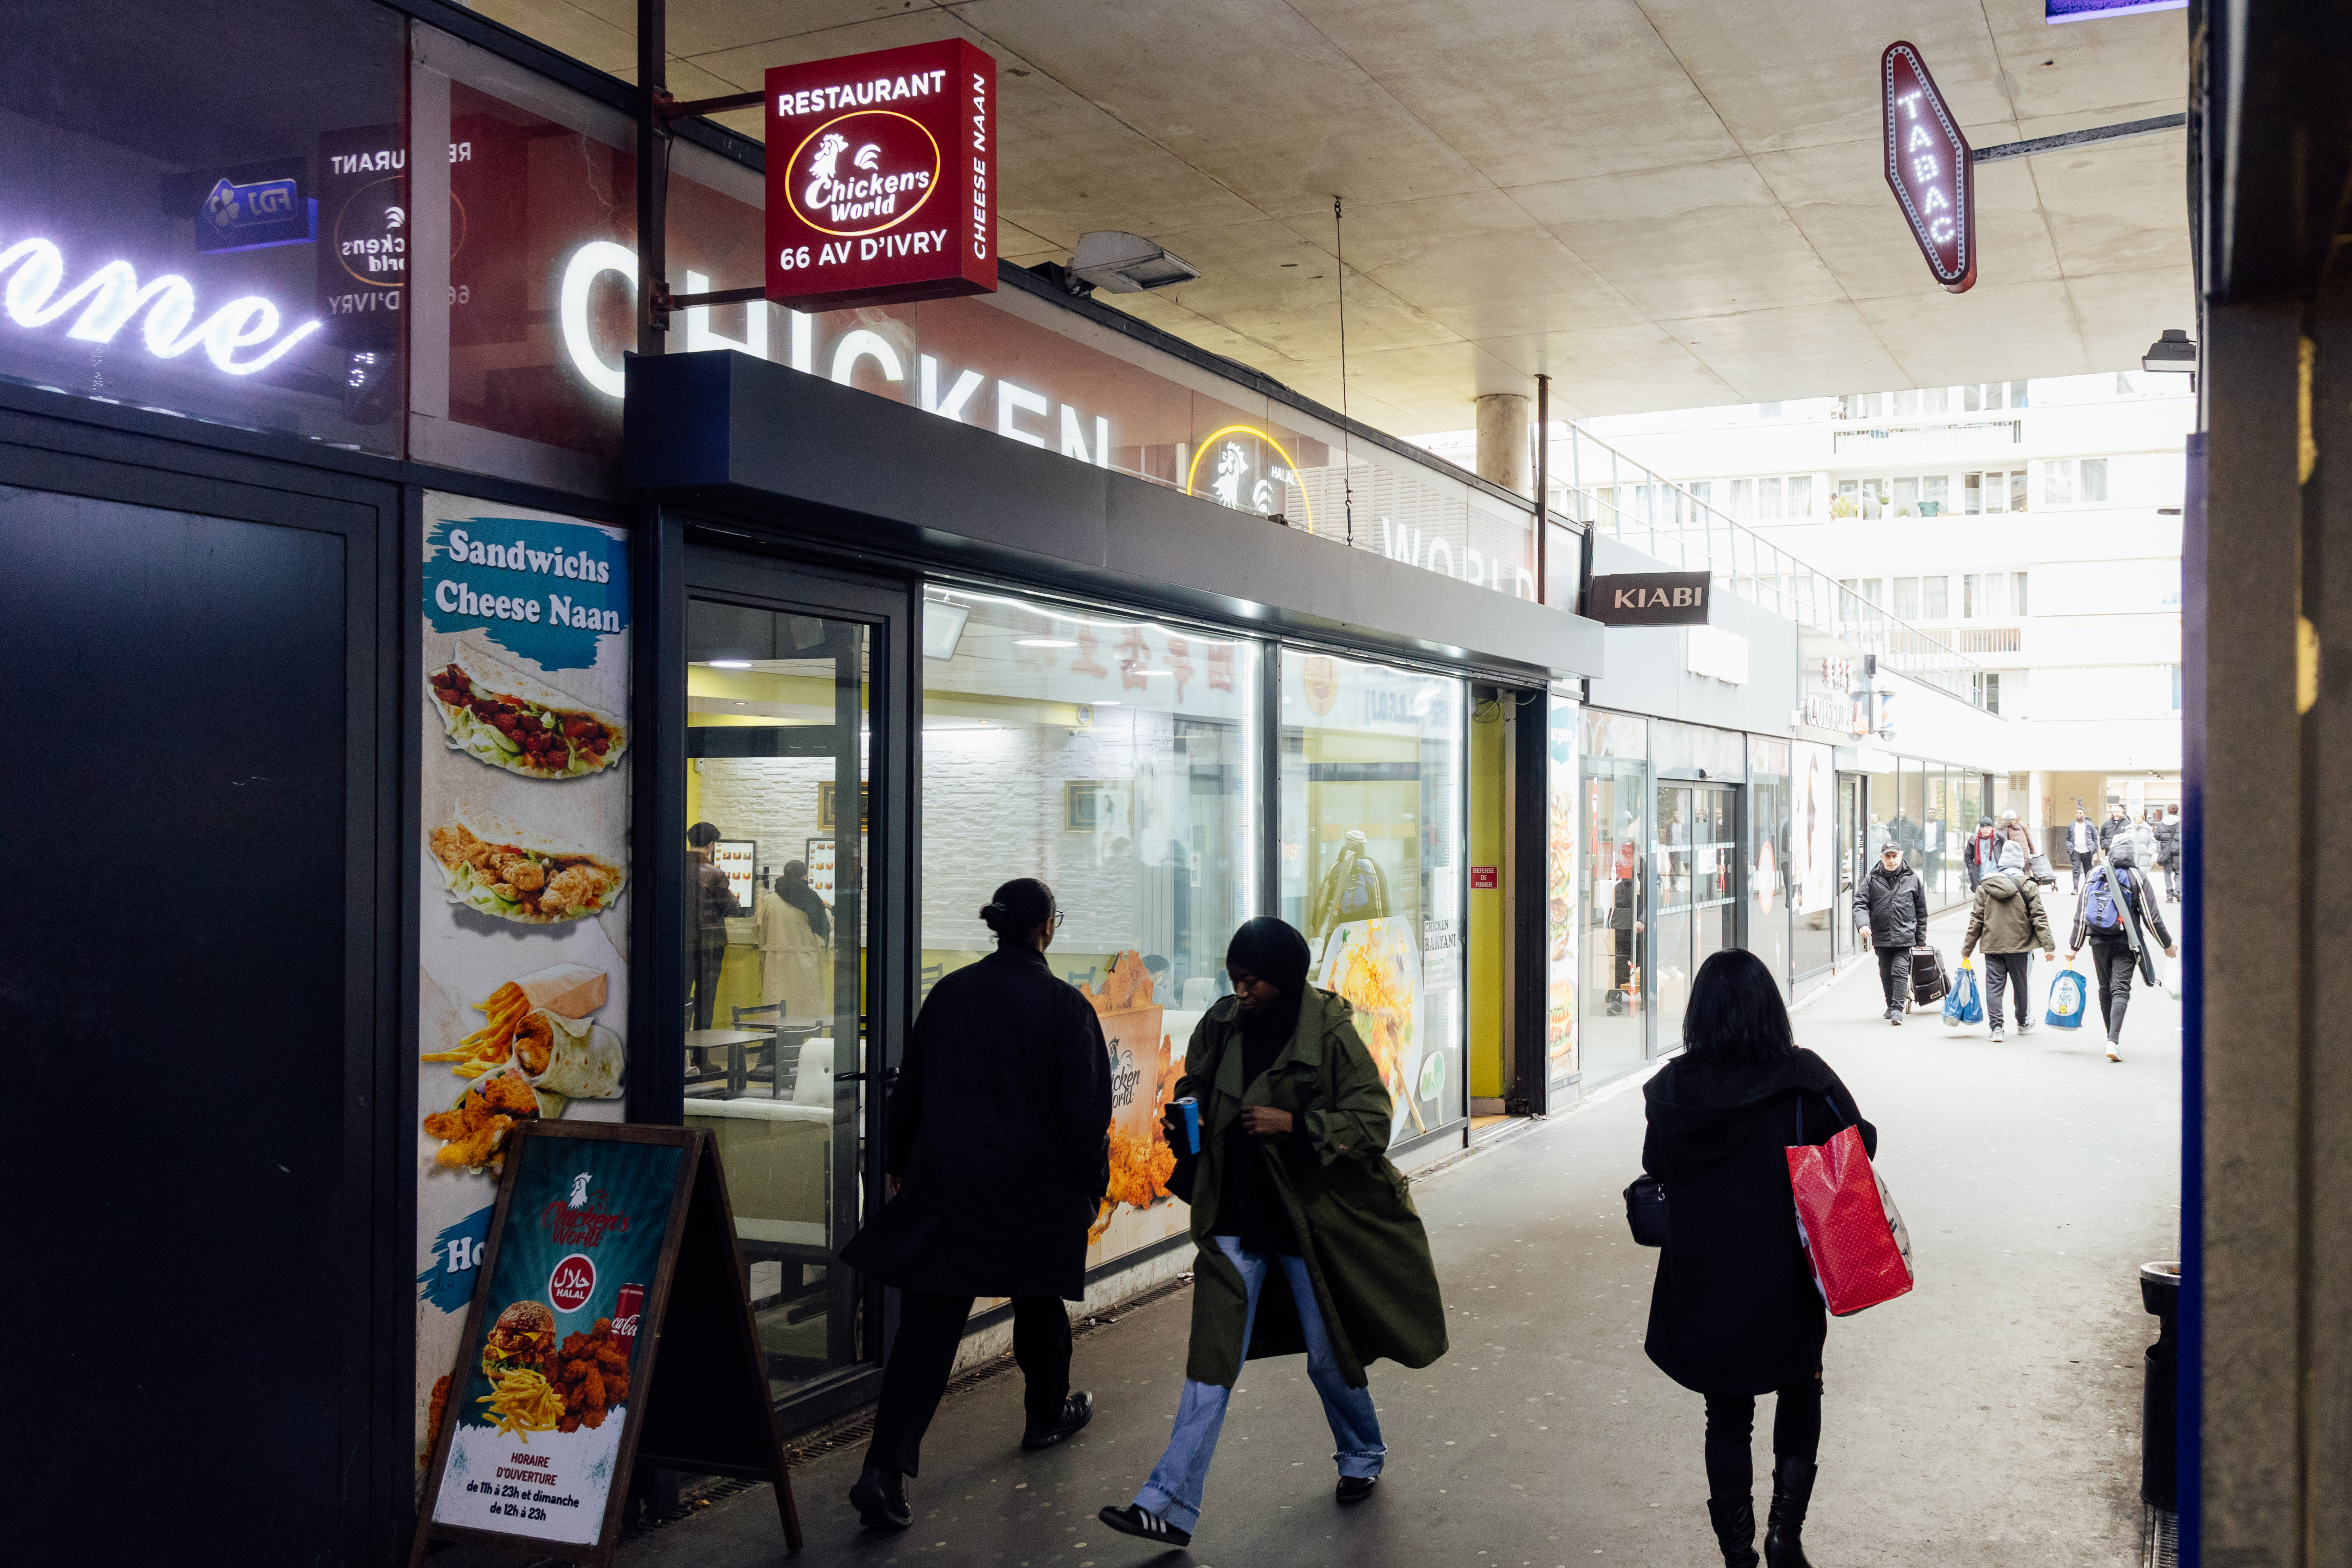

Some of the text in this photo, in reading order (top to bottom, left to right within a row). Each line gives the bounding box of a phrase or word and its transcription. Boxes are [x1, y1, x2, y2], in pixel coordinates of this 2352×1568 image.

[778, 70, 946, 116] RESTAURANT
[973, 73, 986, 260] CHEESE NAAN
[1897, 91, 1955, 243] TABAC
[804, 171, 929, 209] Chicken's
[830, 194, 895, 222] World
[780, 229, 947, 270] 66 AV D'IVRY
[1271, 465, 1296, 486] HALAL
[449, 529, 609, 583] Sandwichs
[435, 579, 620, 632] Cheese Naan
[1614, 587, 1702, 608] KIABI
[1424, 919, 1449, 933] CHICKEN
[1424, 934, 1456, 952] BARYANI
[1111, 1066, 1141, 1092] icken
[1112, 1085, 1133, 1108] orld
[542, 1200, 631, 1232] Chicken's
[552, 1227, 601, 1248] World
[554, 1267, 590, 1288] حلال
[556, 1288, 585, 1300] HALAL
[511, 1452, 550, 1468] HORAIRE
[496, 1466, 557, 1486] D'OUVERTURE
[466, 1479, 579, 1508] de 11h à 23h et dimanche
[490, 1501, 546, 1521] de 12h à 23h
